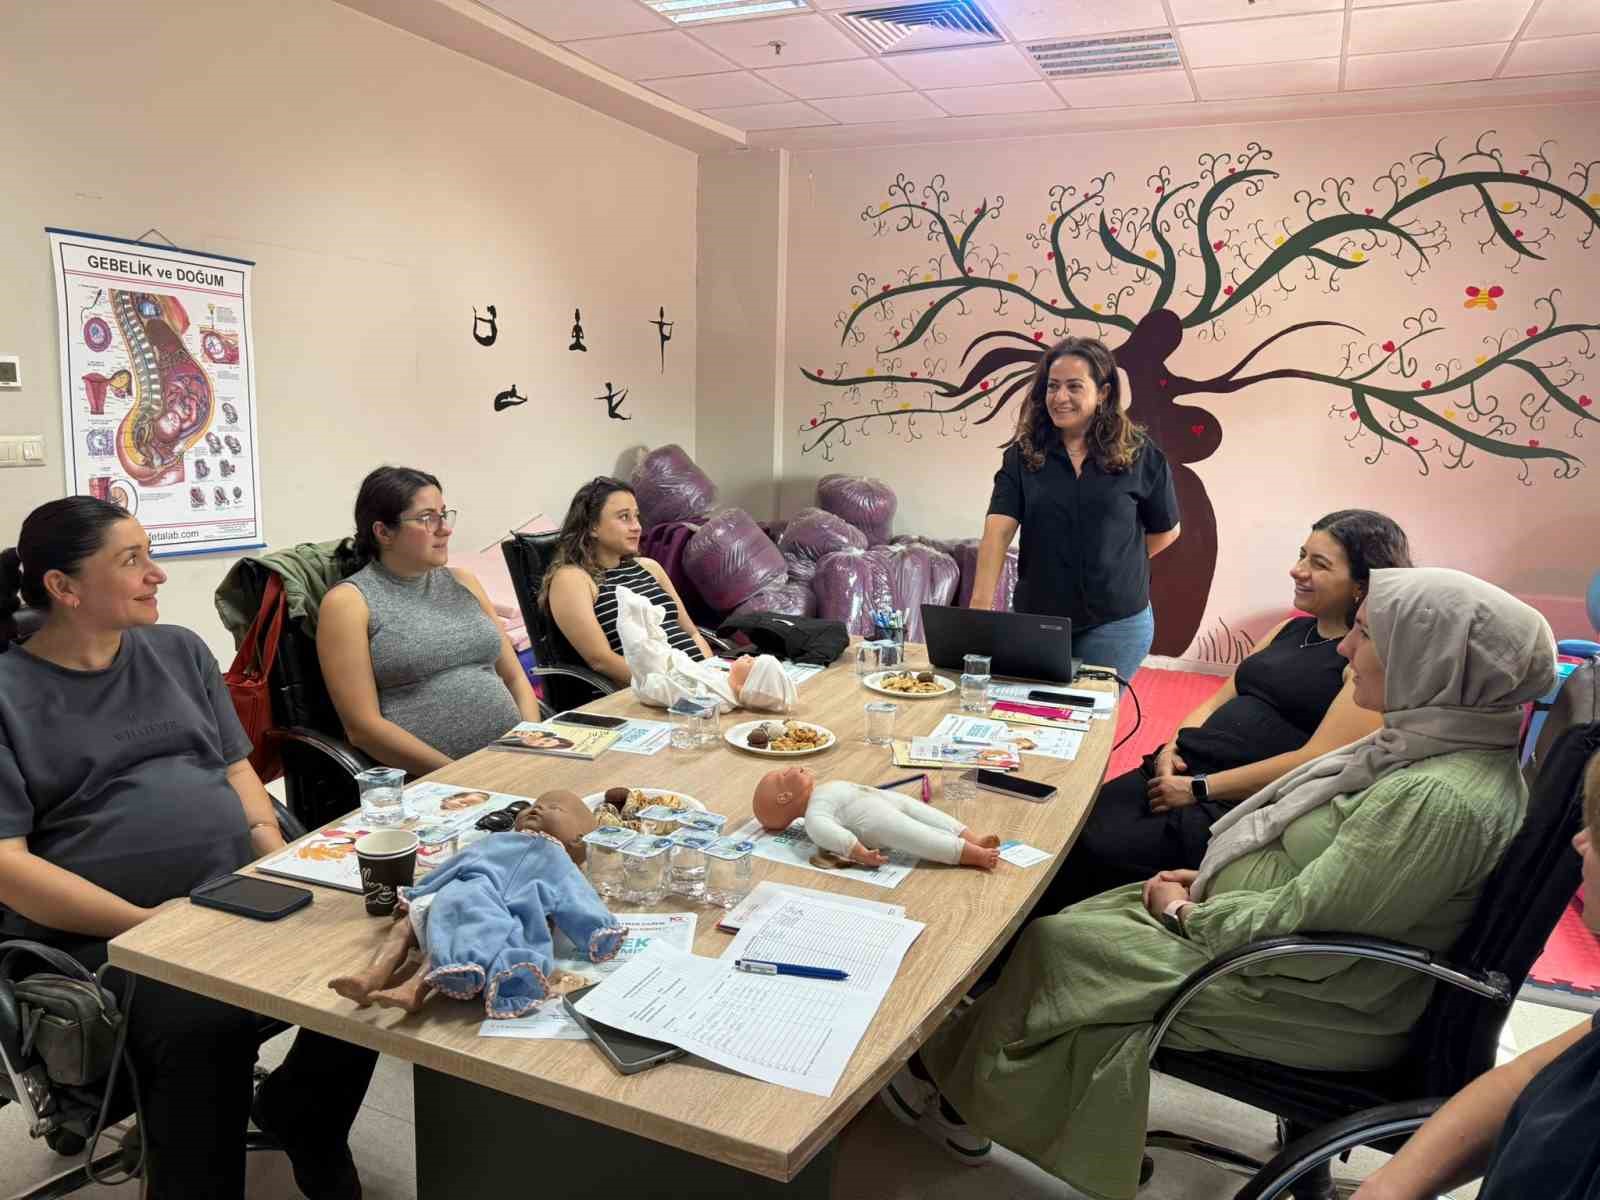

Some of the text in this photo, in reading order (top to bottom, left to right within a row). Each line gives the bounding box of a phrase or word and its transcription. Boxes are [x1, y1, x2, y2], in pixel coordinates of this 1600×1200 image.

[87, 255, 224, 287] GEBELİK ve DOĞUM
[149, 529, 199, 541] etalab.com
